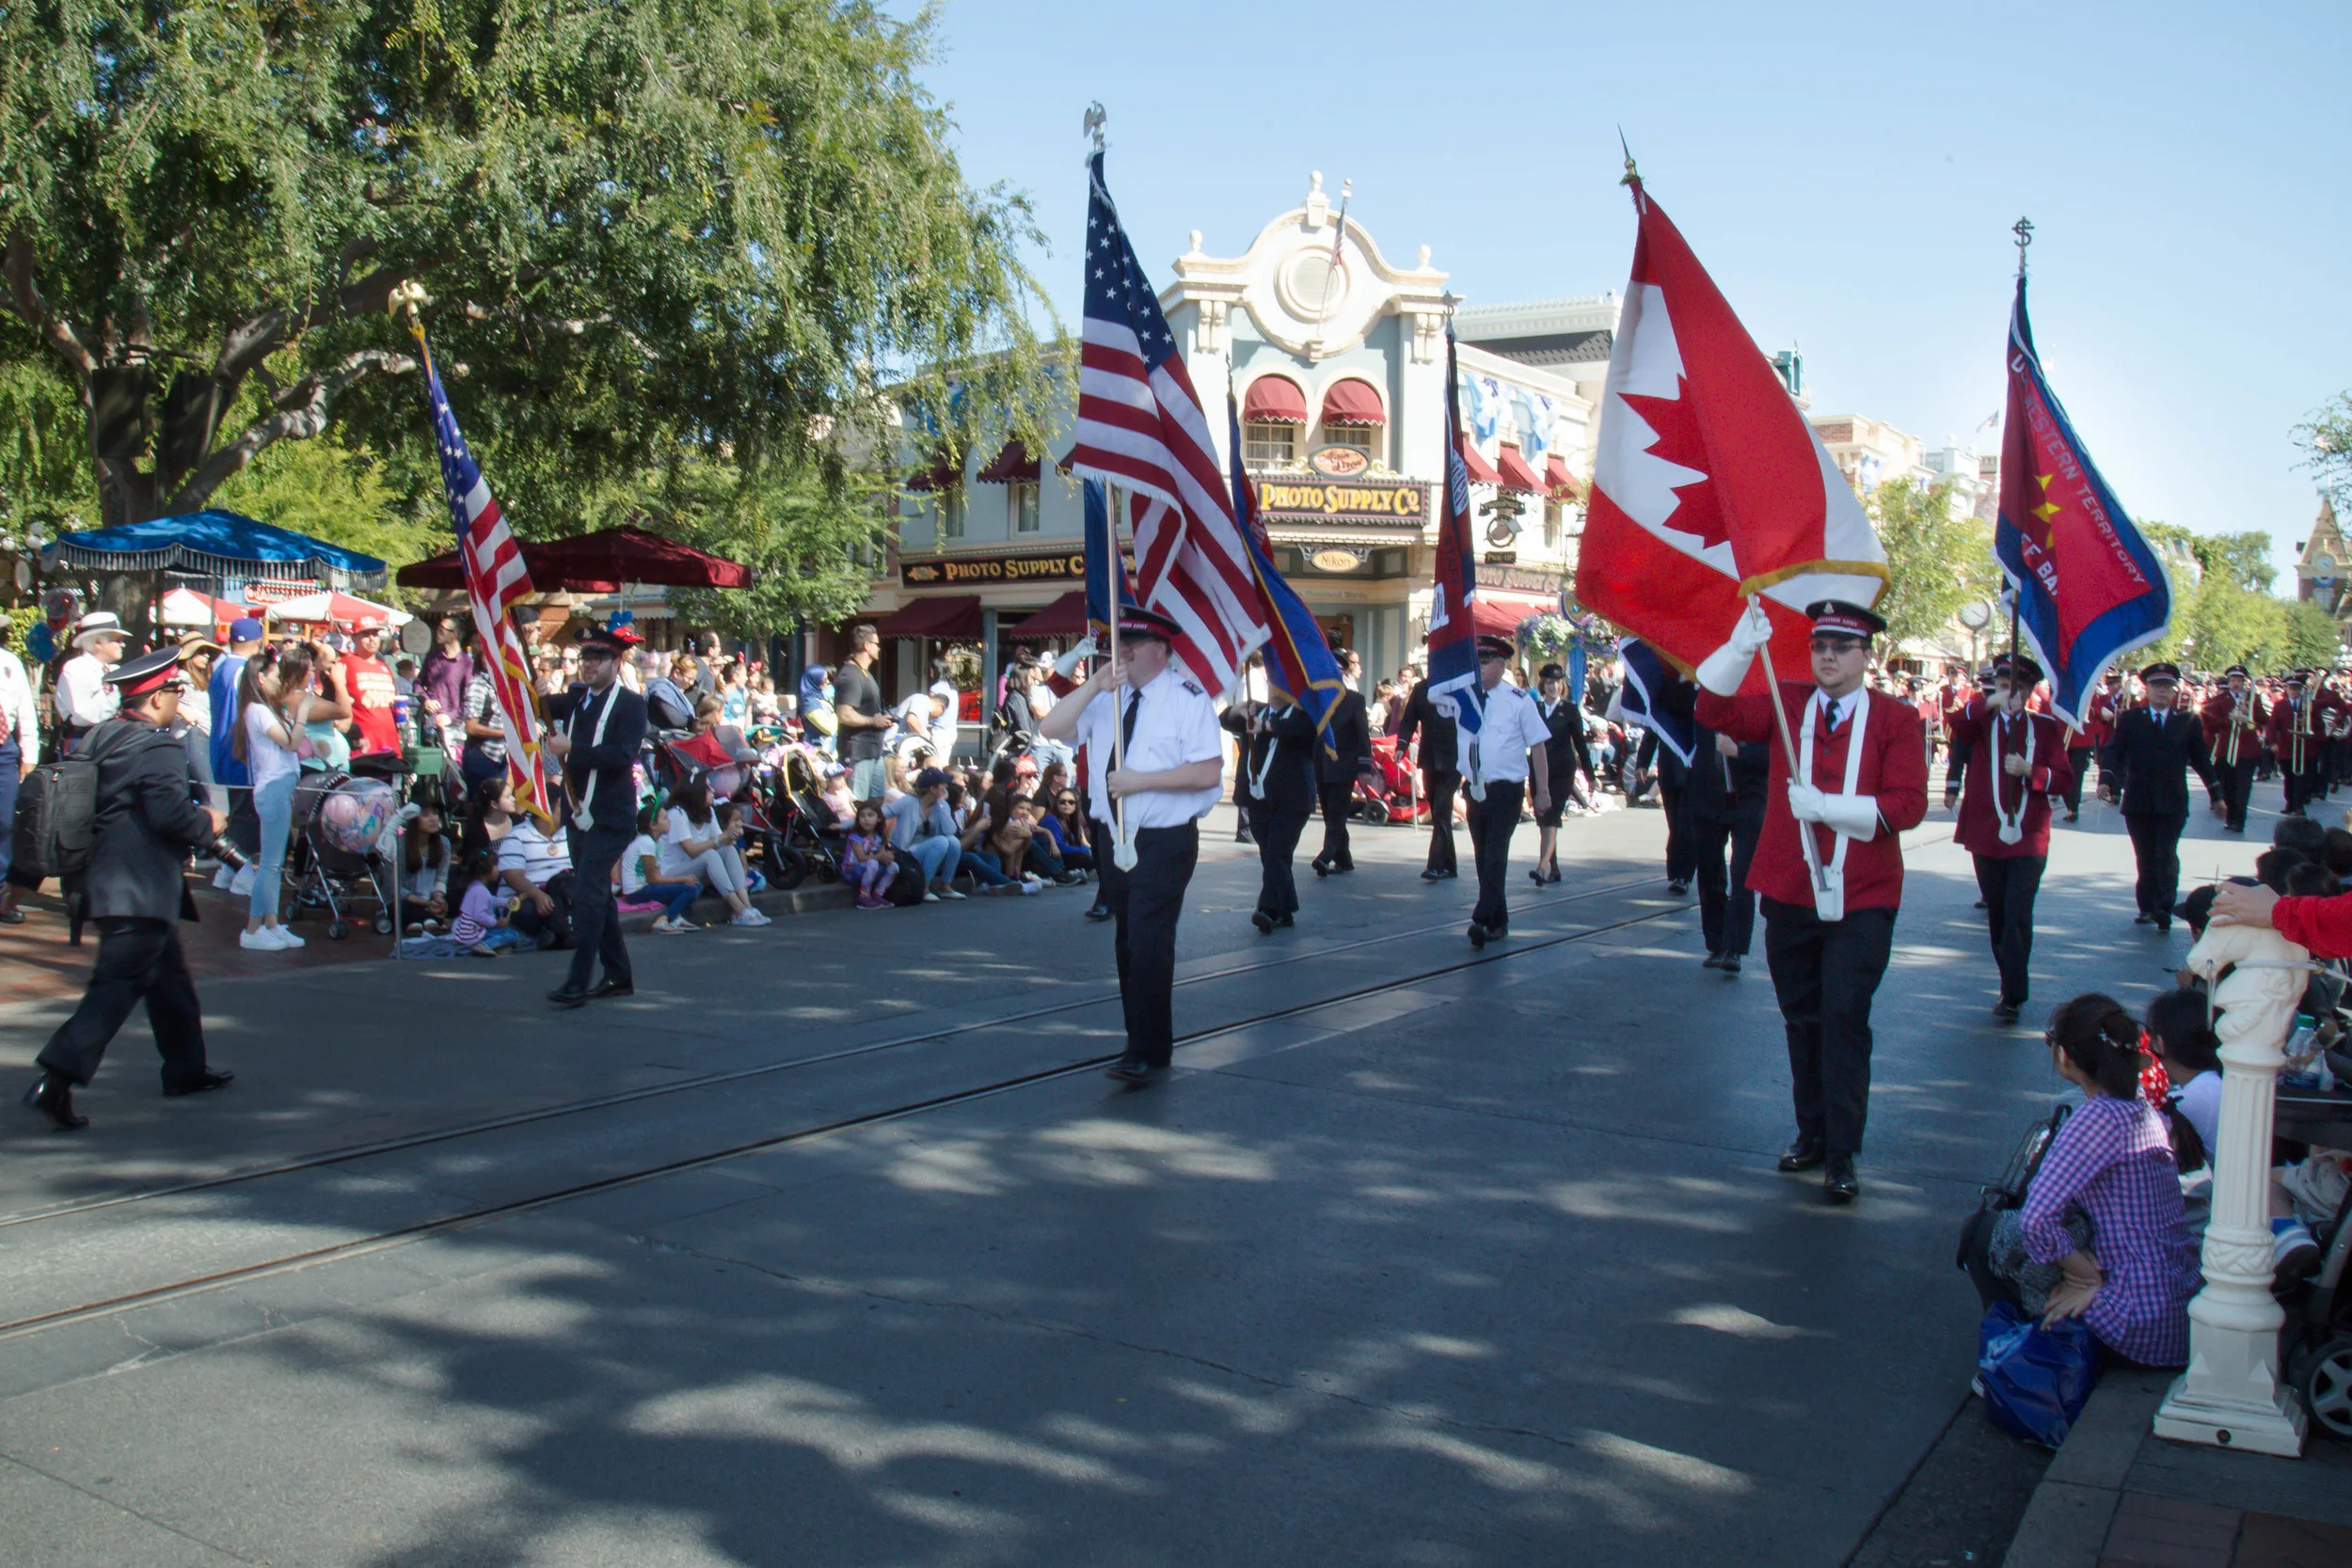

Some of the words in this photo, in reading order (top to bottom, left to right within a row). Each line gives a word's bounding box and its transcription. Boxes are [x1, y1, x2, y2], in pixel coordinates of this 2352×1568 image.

[1260, 483, 1324, 511] PHOTO
[1324, 485, 1394, 514] SUPPLY
[2076, 484, 2145, 583] TERRITORY
[944, 562, 1001, 581] PHOTO
[1005, 558, 1067, 578] SUPPLY
[1069, 555, 1085, 575] C
[1321, 554, 1351, 567] Nikon
